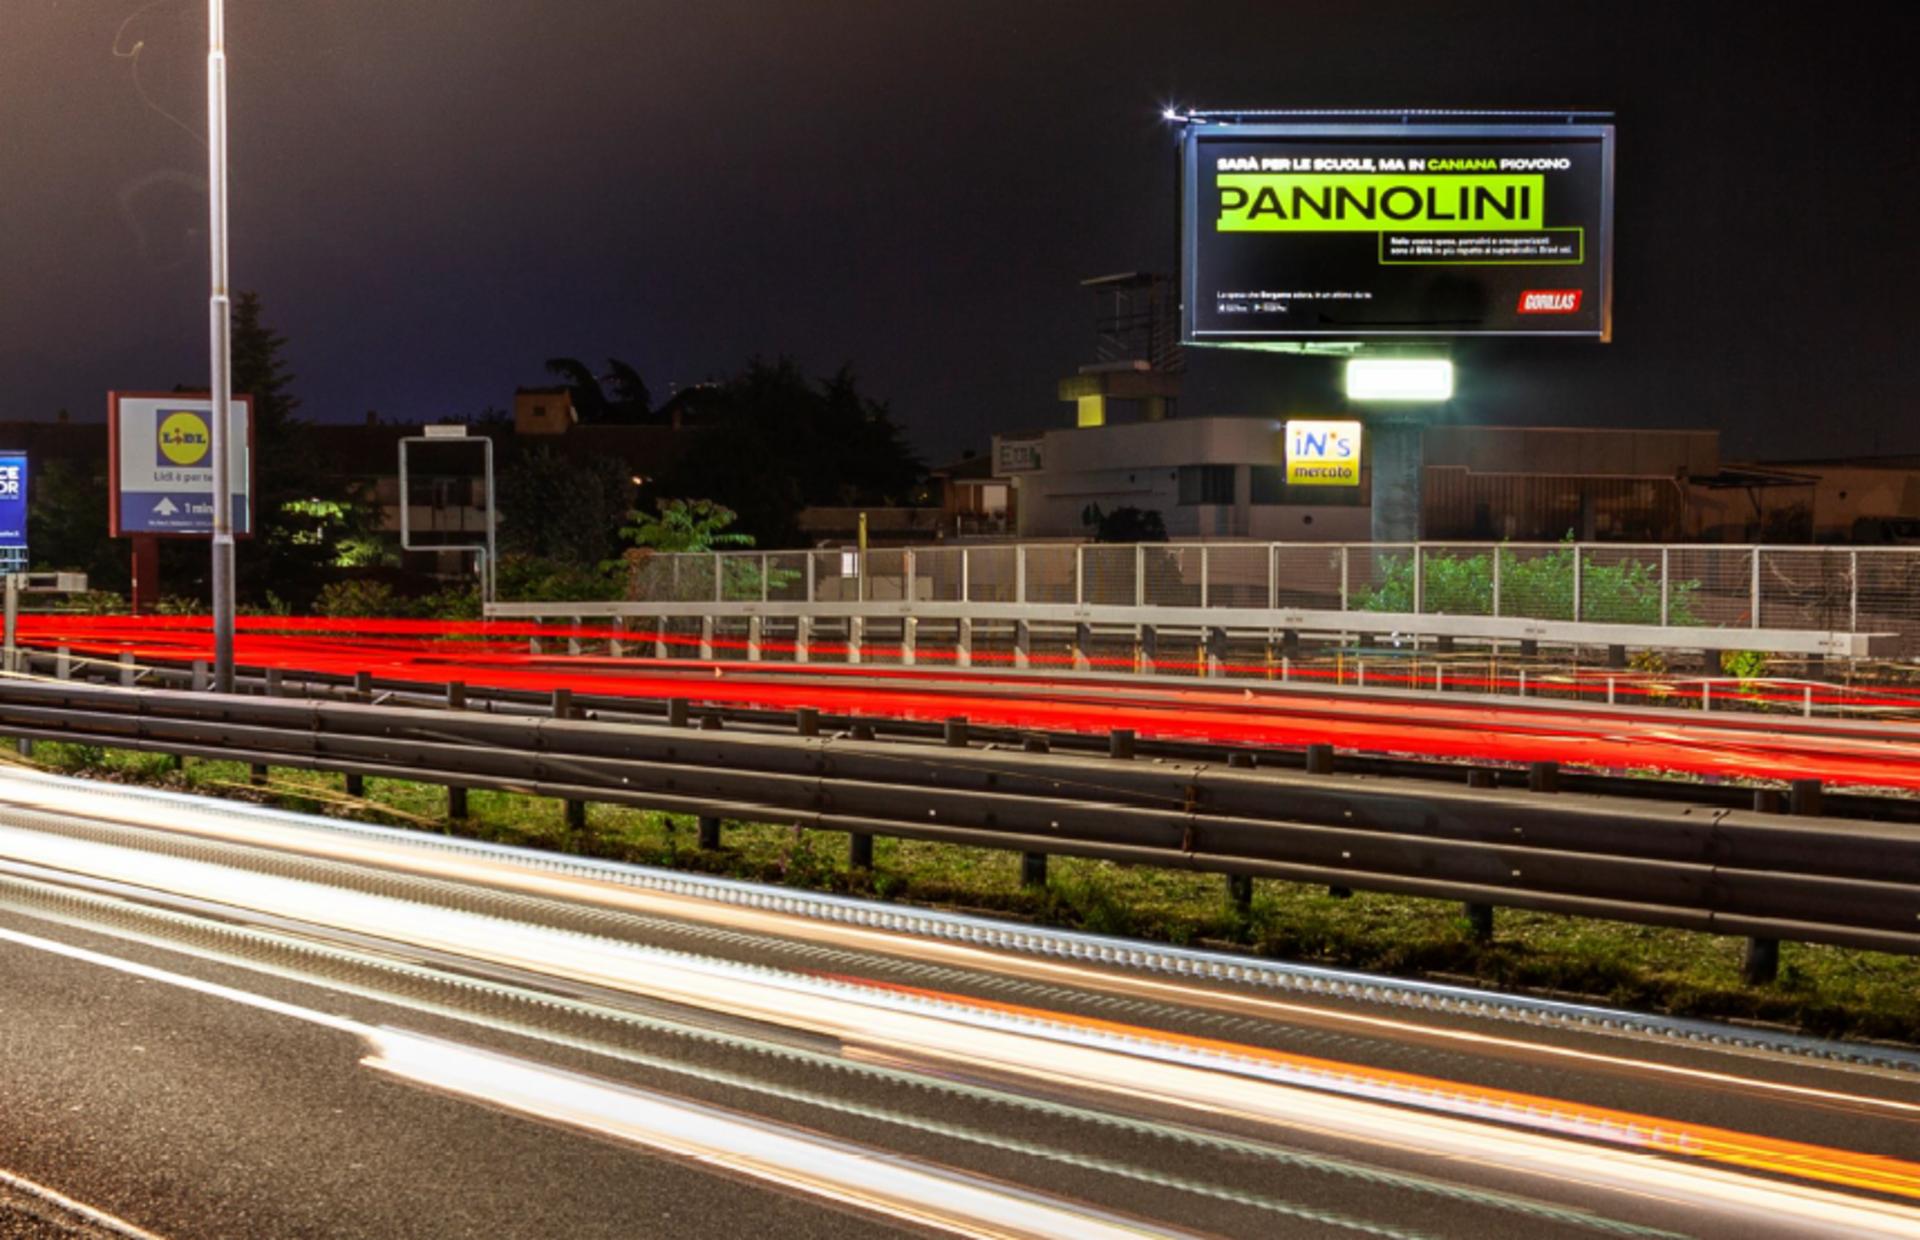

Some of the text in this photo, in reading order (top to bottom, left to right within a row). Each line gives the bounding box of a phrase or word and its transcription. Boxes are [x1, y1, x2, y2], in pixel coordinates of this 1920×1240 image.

[1217, 155, 1571, 173] SARÀ PER LE SCUOLE, MA IN CANIANA PIOVONO
[1217, 185, 1531, 221] PANNOLINI
[1524, 293, 1576, 310] GORILLAS
[154, 471, 174, 482] Lidl
[183, 473, 201, 484] per
[1295, 466, 1352, 479] mercato
[184, 502, 191, 514] 1
